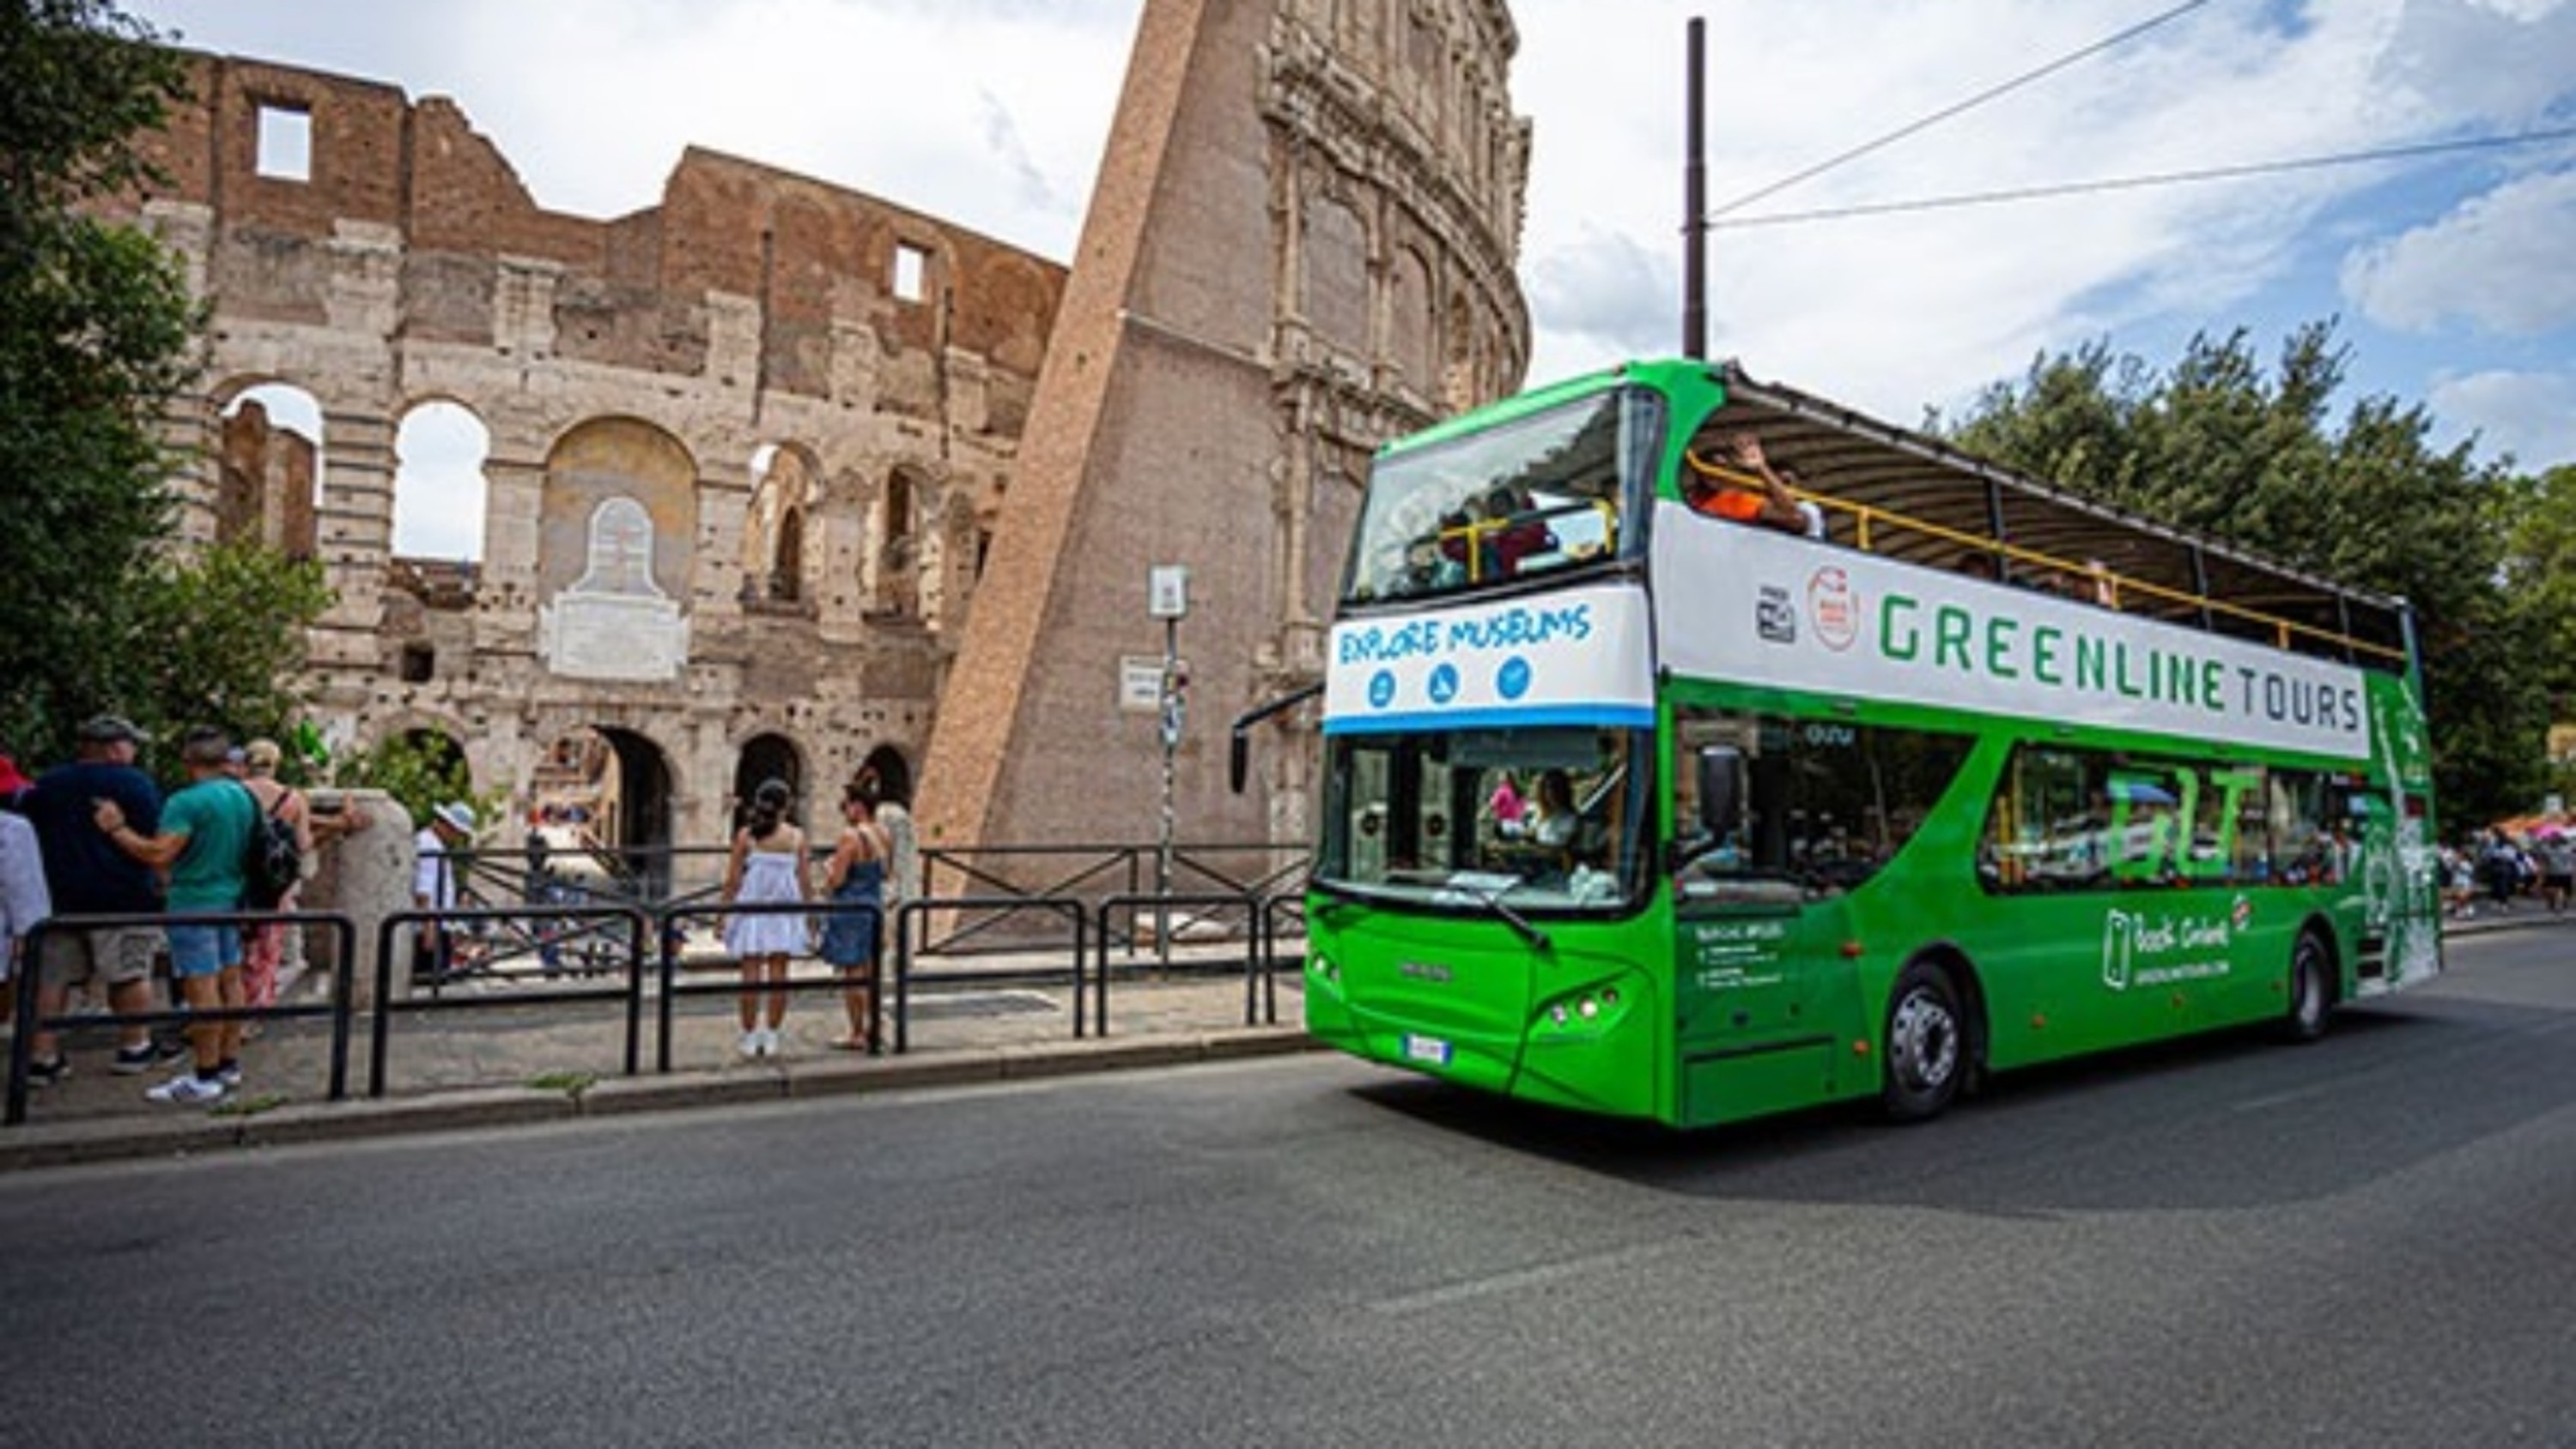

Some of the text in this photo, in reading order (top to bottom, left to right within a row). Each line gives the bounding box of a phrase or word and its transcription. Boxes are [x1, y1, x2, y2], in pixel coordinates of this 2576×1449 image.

[1340, 603, 1591, 665] EXPLORE MUSEUMS
[1880, 594, 2226, 711] GREENLINE
[2236, 666, 2360, 732] TOURS
